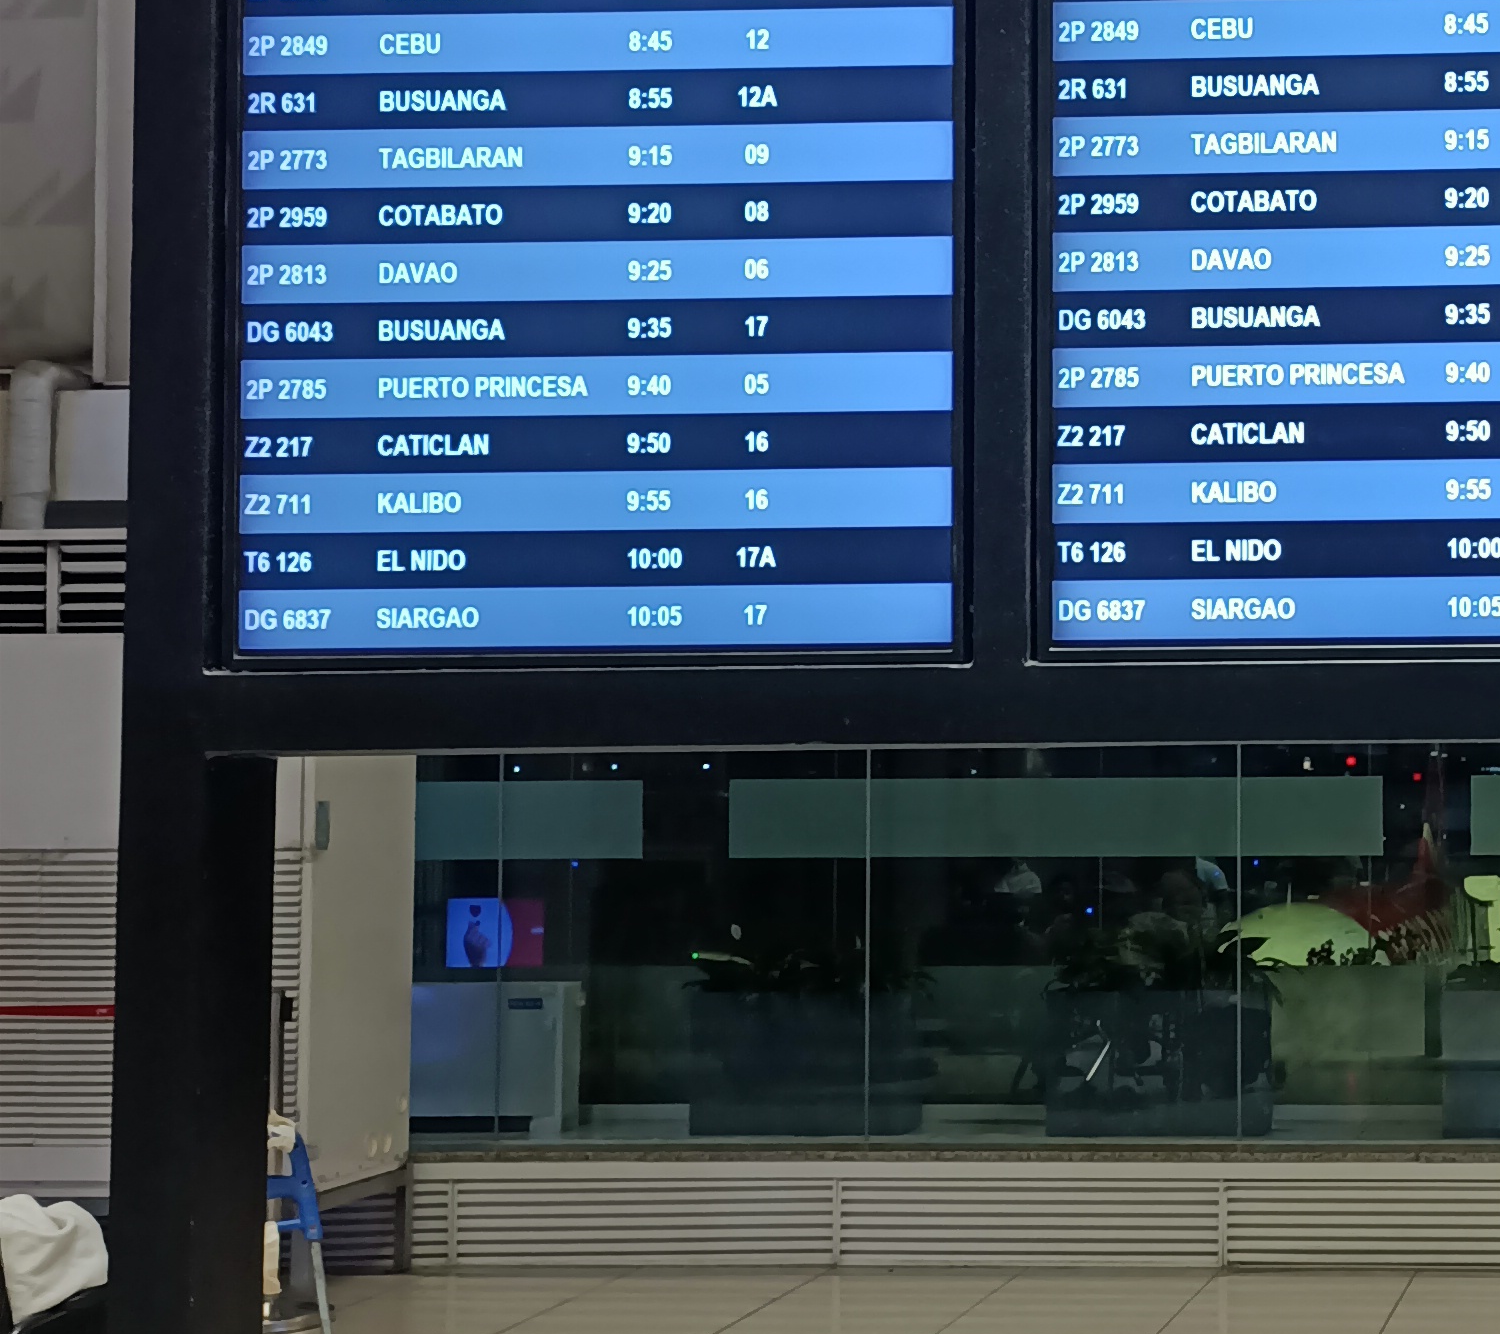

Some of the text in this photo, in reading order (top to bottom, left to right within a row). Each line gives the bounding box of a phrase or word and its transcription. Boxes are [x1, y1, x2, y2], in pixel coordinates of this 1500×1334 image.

[248, 84, 778, 114] 2R 631 BUSUANGA 8:55 12A
[1058, 193, 1086, 215] 2P
[1090, 192, 1139, 215] 2959
[1190, 189, 1318, 213] COTABATO
[1444, 186, 1490, 209] 9:20
[1058, 308, 1092, 331] DG
[1097, 308, 1146, 331] 6043
[1191, 304, 1321, 329] BUSUANGA
[1444, 302, 1491, 325] 9:35
[246, 373, 770, 400] 2P 2785 PUERTO PRINCESA 9:40 05
[1057, 541, 1084, 563] T6
[1089, 541, 1126, 563] 126
[1191, 539, 1221, 562] EL
[1225, 538, 1282, 562] NIDO
[245, 604, 768, 631] DG 6837 SIARGAO 10:05 17
